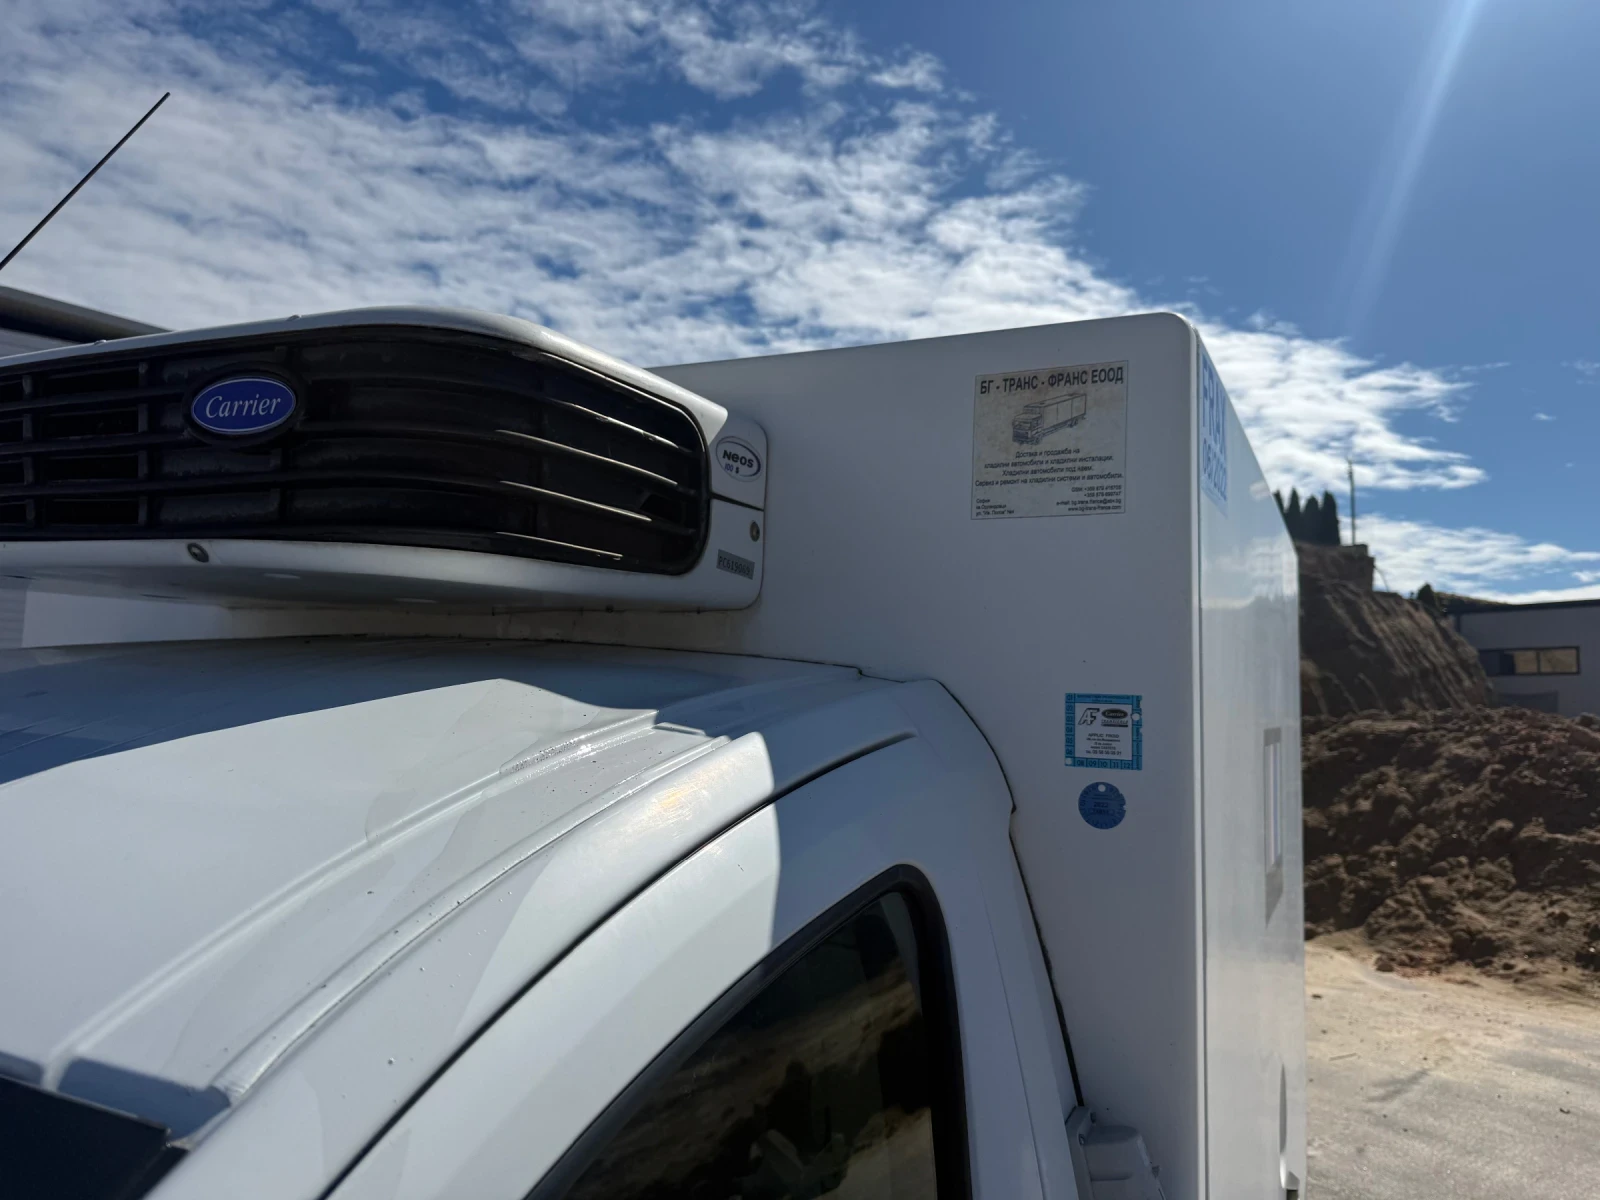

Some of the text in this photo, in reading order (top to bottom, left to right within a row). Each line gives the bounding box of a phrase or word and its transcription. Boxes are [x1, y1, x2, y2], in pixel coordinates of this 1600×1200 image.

[980, 380, 994, 394] БГ
[1002, 376, 1038, 392] ТРАНС
[1048, 370, 1088, 387] ФРАНС
[1091, 367, 1124, 384] ЕООД
[206, 394, 281, 418] Carrier
[1044, 448, 1072, 456] продажба
